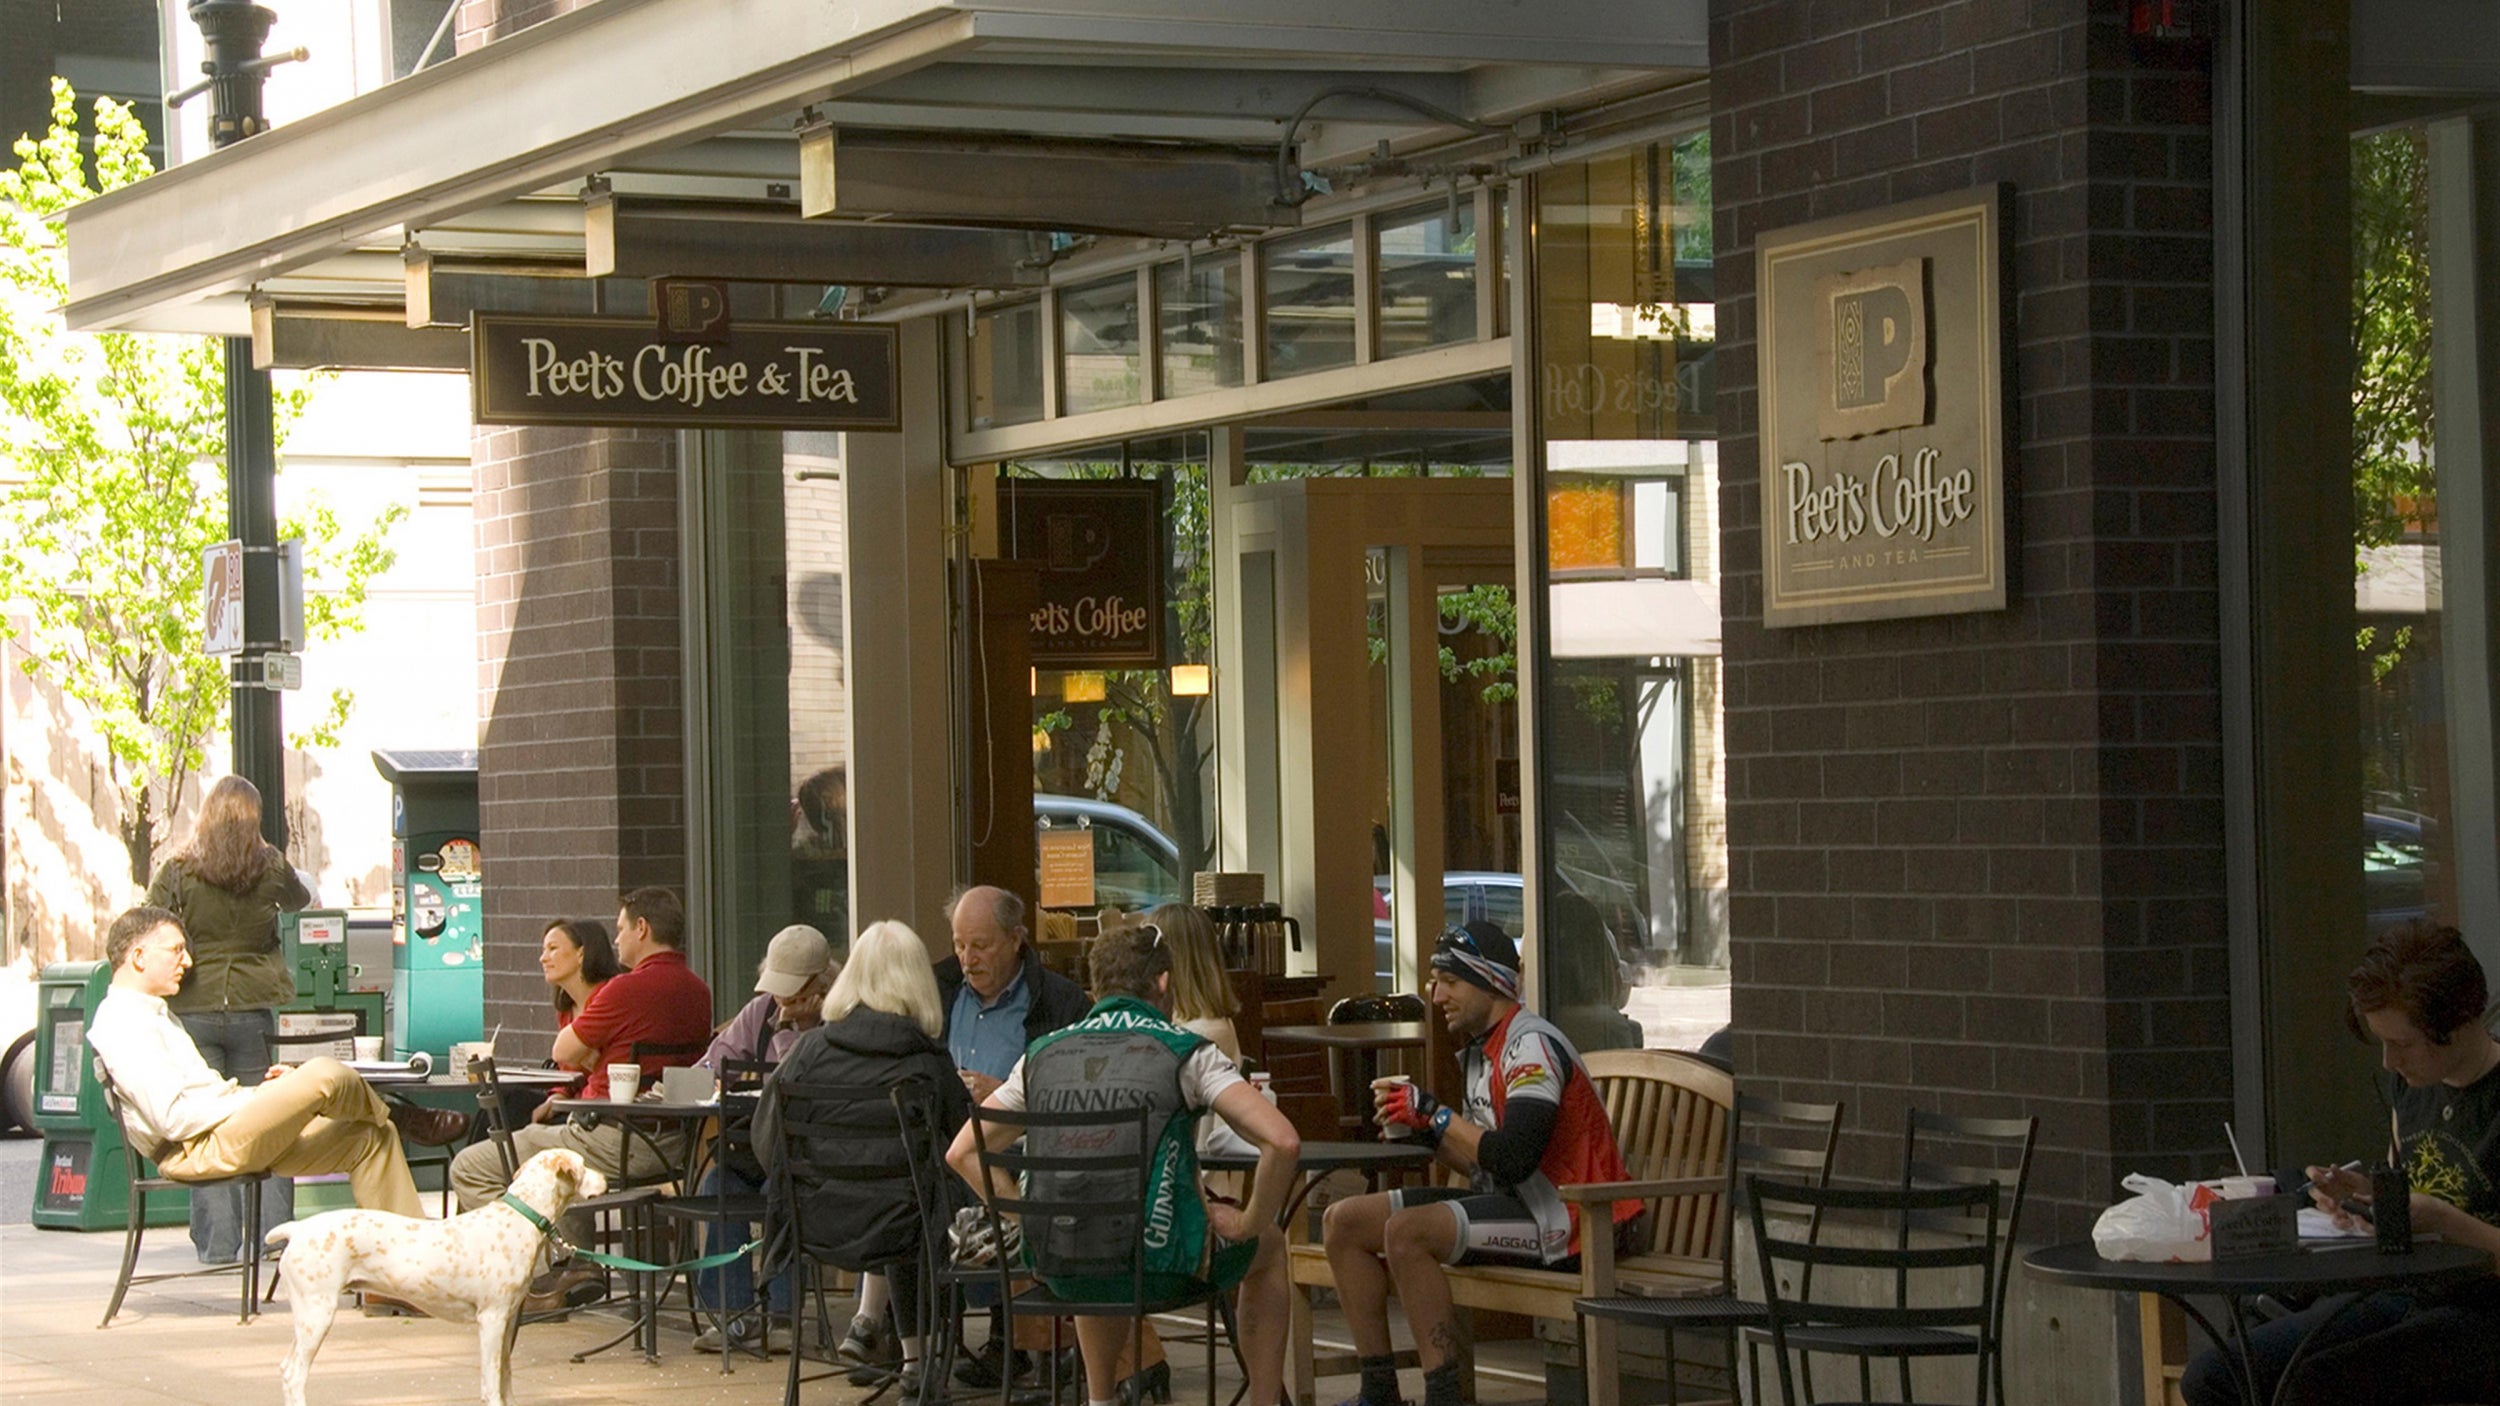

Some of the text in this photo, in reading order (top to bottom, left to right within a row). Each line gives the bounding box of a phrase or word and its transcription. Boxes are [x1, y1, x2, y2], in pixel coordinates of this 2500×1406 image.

[520, 338, 858, 407] Peet's Coffee & Tea
[1782, 445, 1974, 545] Peet's Coffee
[1839, 549, 1919, 570] AND TEA
[1074, 596, 1147, 639] Coffee
[1143, 1136, 1181, 1249] GUINNESS
